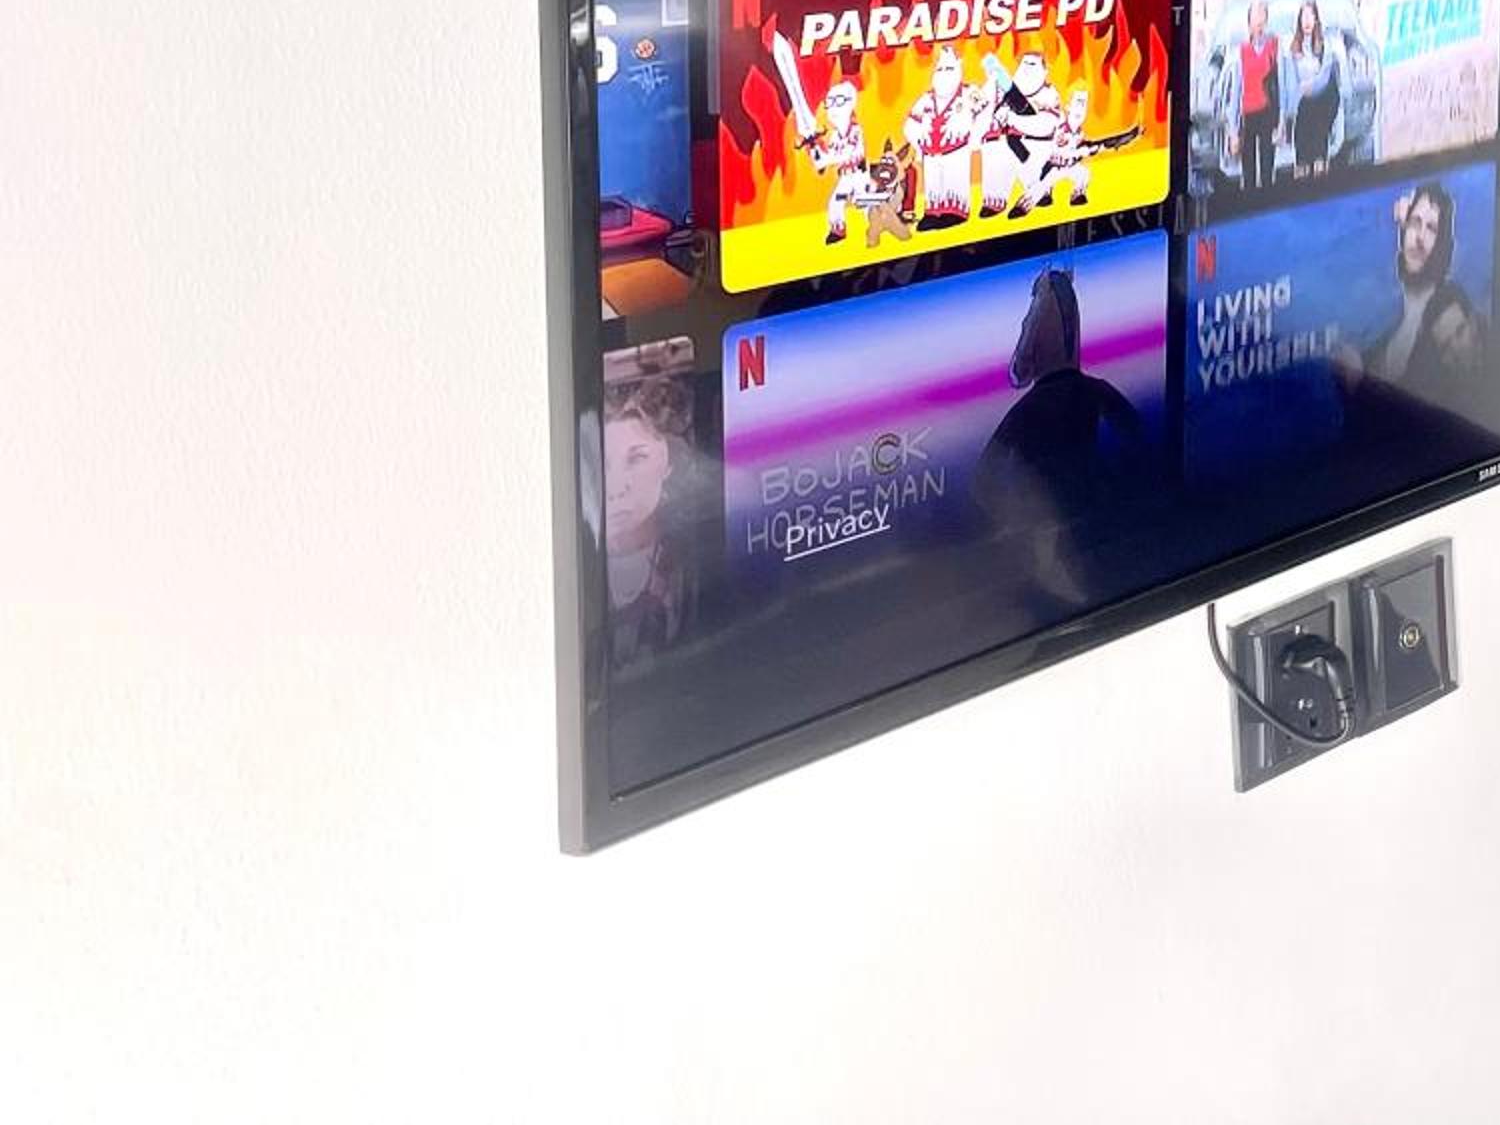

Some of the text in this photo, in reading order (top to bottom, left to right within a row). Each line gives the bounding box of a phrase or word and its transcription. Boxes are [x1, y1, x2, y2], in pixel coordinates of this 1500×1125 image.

[1197, 275, 1291, 328] LIVING
[737, 333, 767, 392] N
[1199, 310, 1273, 360] WITH
[760, 427, 934, 505] BOJACK
[746, 466, 946, 555] HORSEMAN
[785, 502, 891, 556] Privacy
